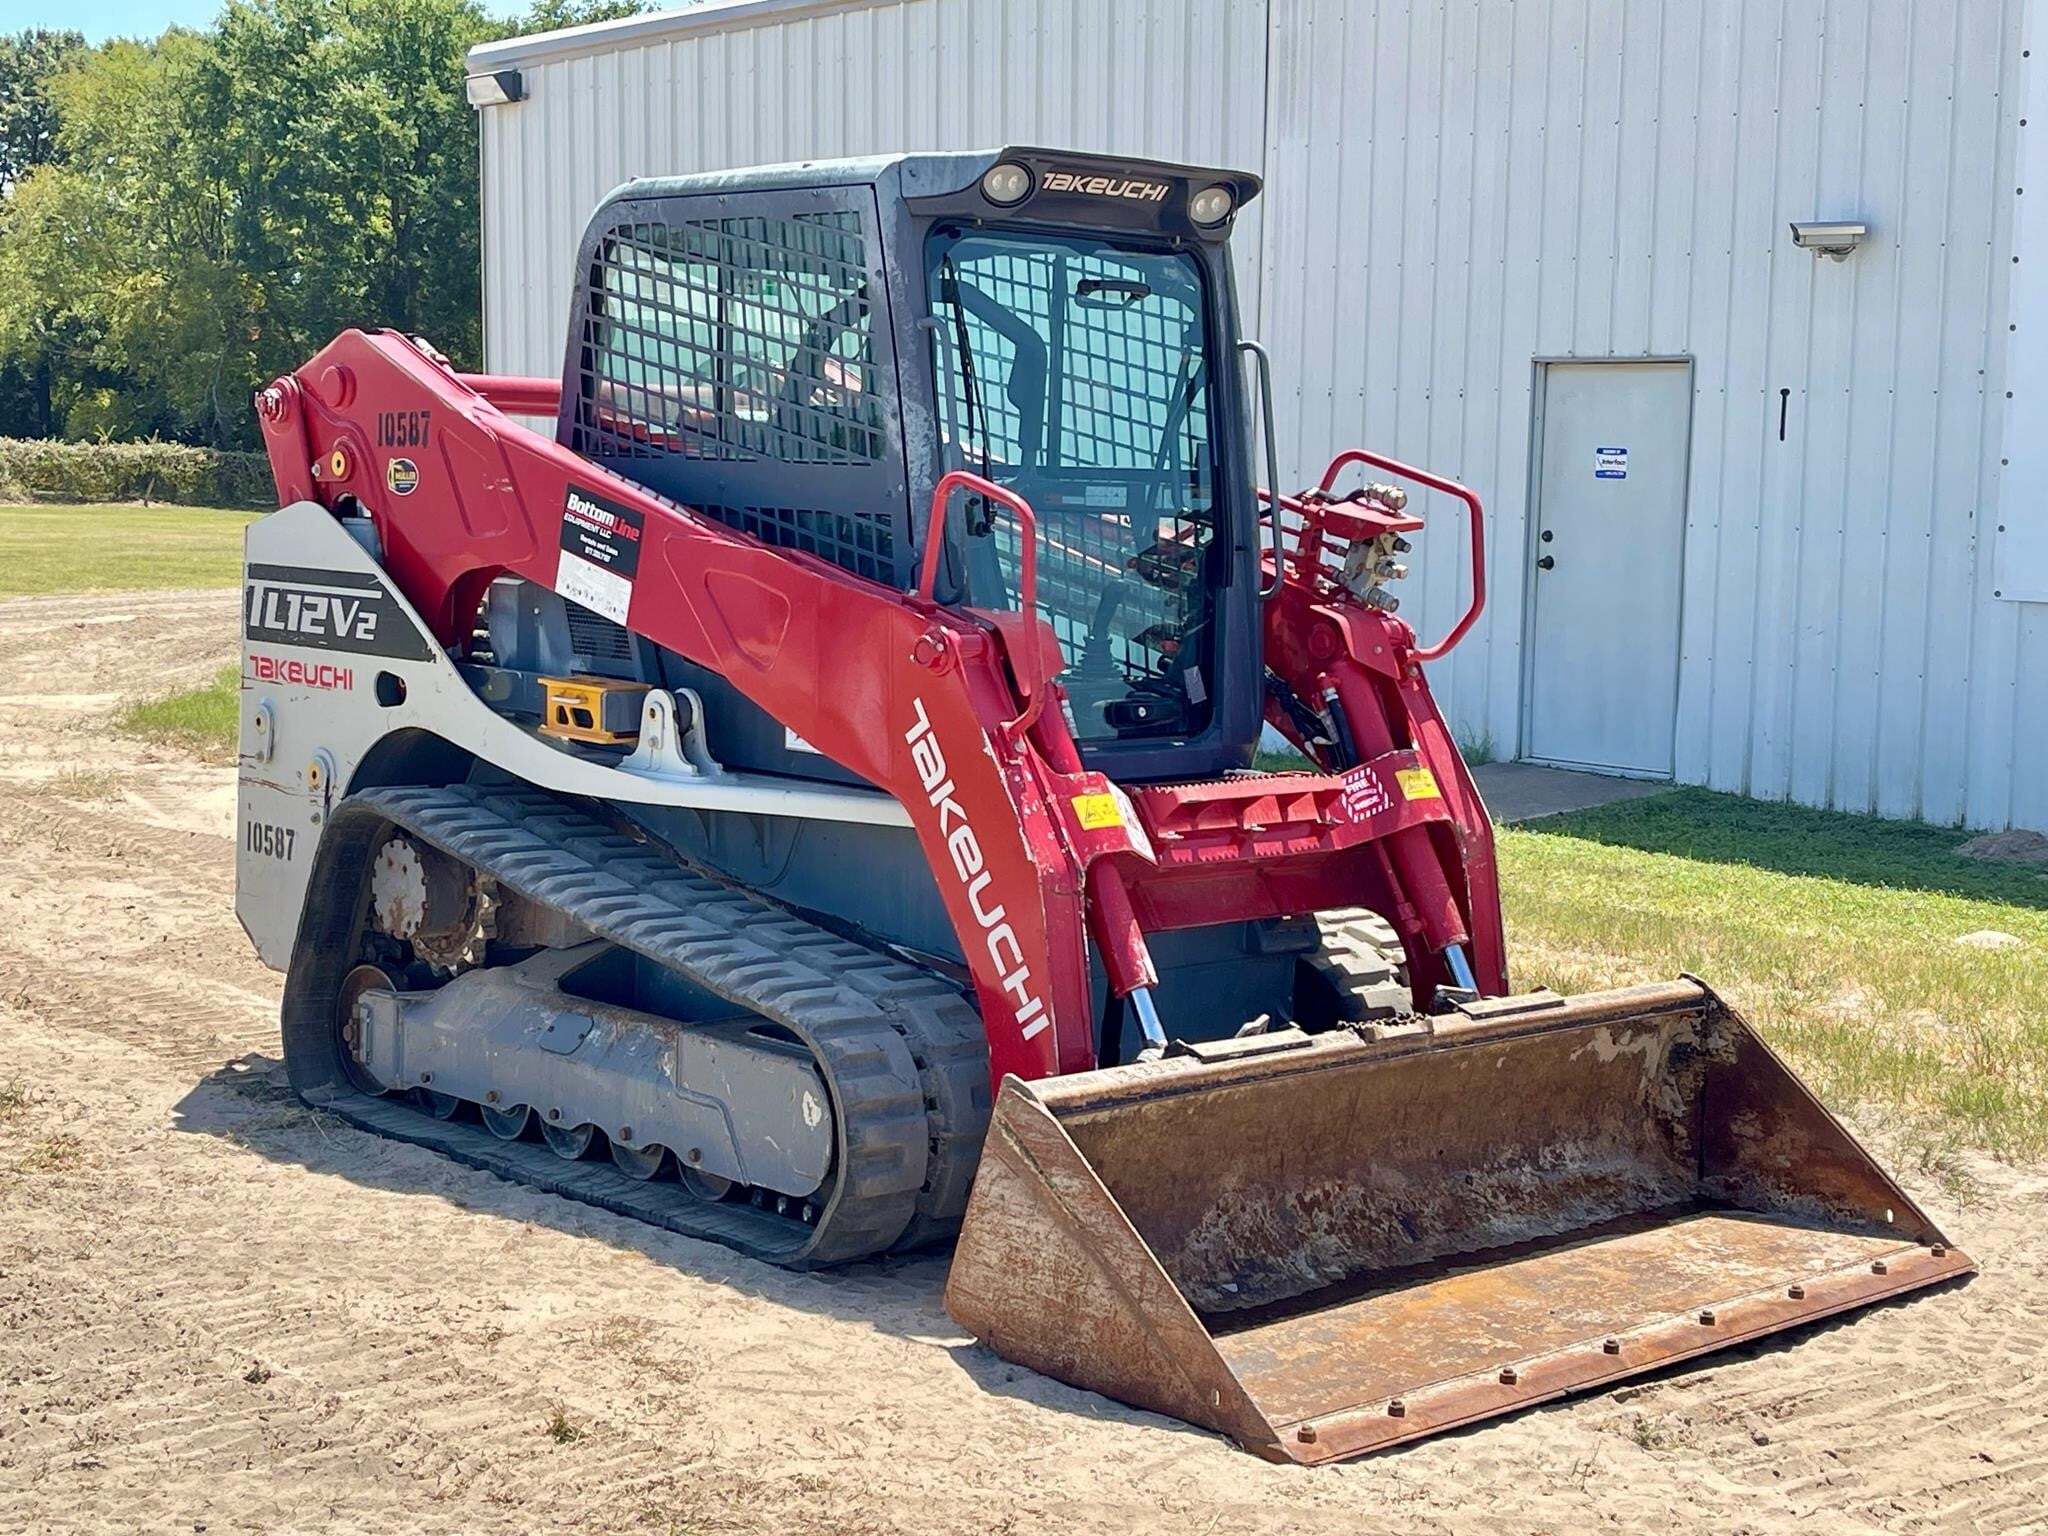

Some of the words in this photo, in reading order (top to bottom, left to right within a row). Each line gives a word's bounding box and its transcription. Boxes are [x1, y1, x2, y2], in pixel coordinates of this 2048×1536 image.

[1042, 172, 1169, 201] TAKEUCHI
[377, 410, 431, 448] 10587
[249, 655, 354, 691] TAKEUCHI
[246, 820, 296, 862] 10587
[904, 696, 1050, 1041] TAKEUCHI
